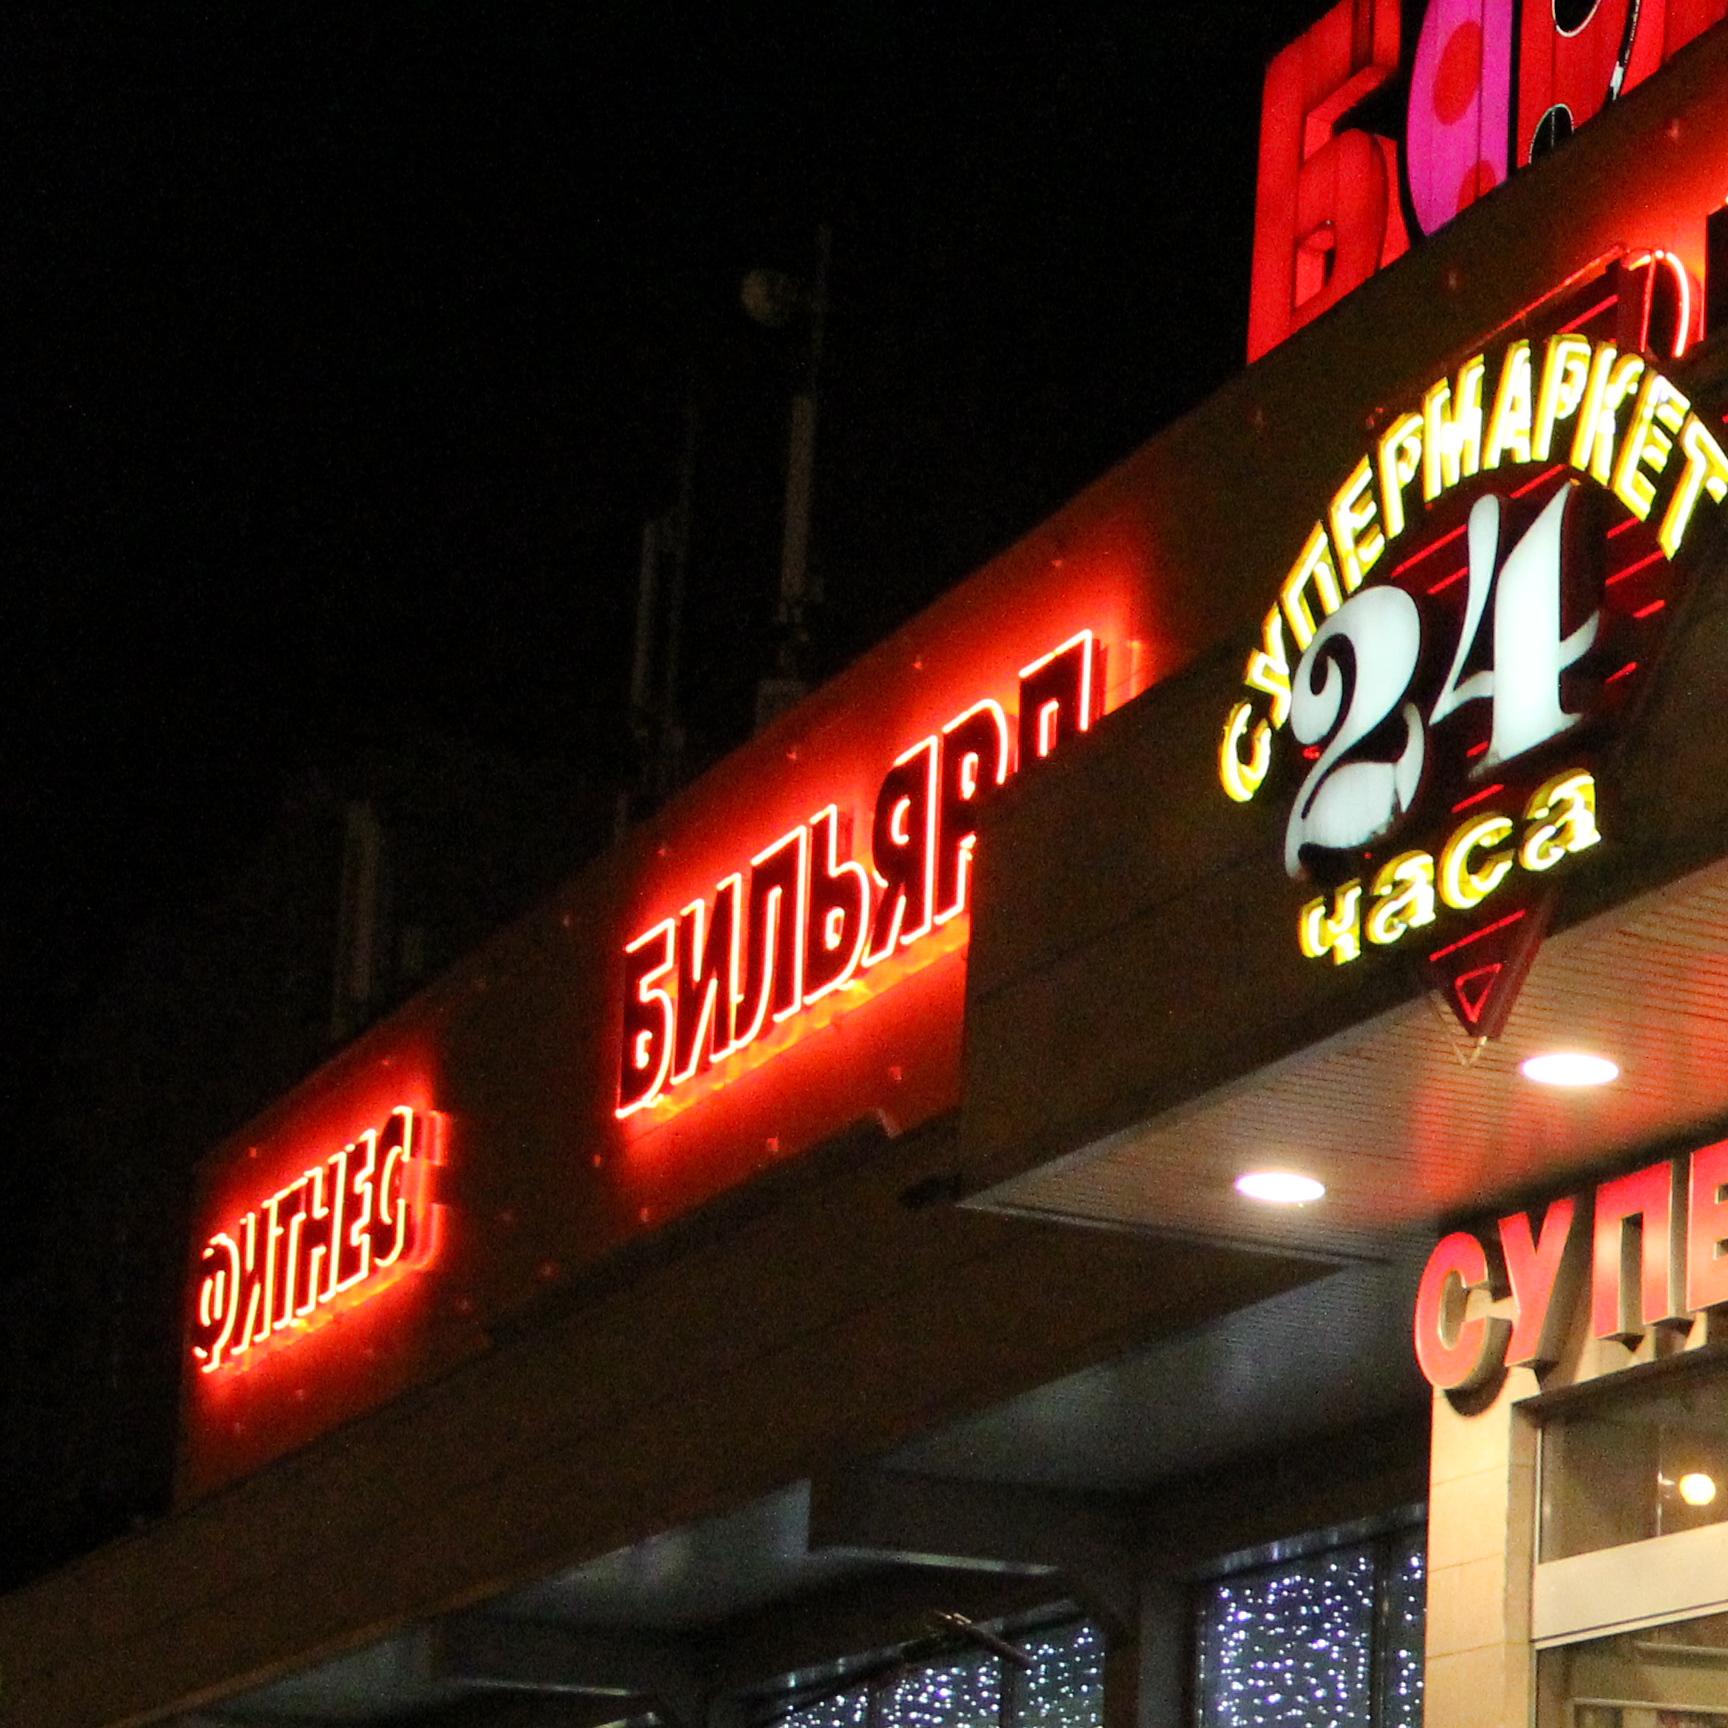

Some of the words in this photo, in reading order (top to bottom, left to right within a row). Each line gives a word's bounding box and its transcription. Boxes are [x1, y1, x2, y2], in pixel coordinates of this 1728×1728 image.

[1285, 480, 1602, 880] 24
[1299, 768, 1602, 966] часа
[193, 1104, 414, 1374] ФИТНЕС
